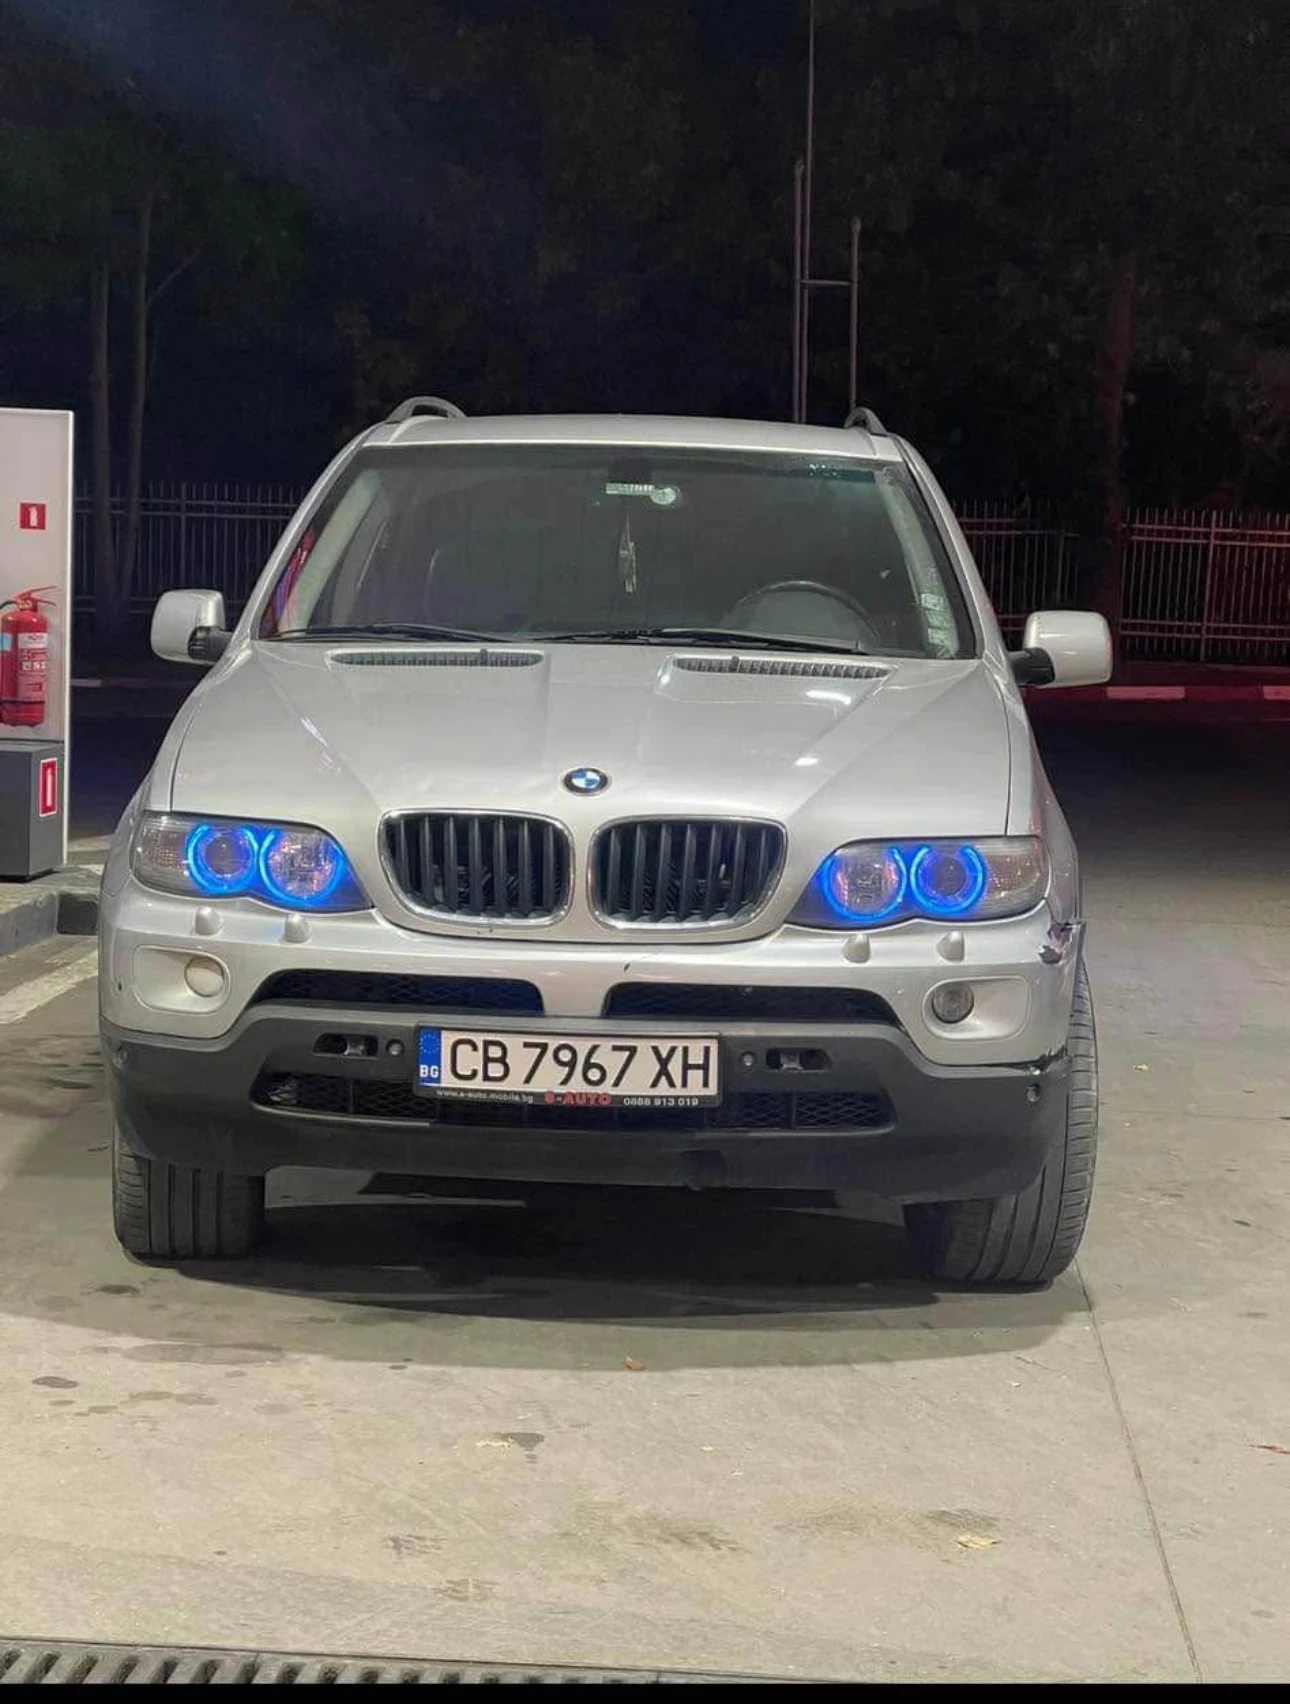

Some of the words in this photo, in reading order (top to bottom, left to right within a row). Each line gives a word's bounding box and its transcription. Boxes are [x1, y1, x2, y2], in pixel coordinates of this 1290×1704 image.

[419, 1065, 439, 1078] BG
[450, 1037, 510, 1082] CB
[522, 1041, 638, 1088] 7967
[650, 1045, 711, 1088] XH
